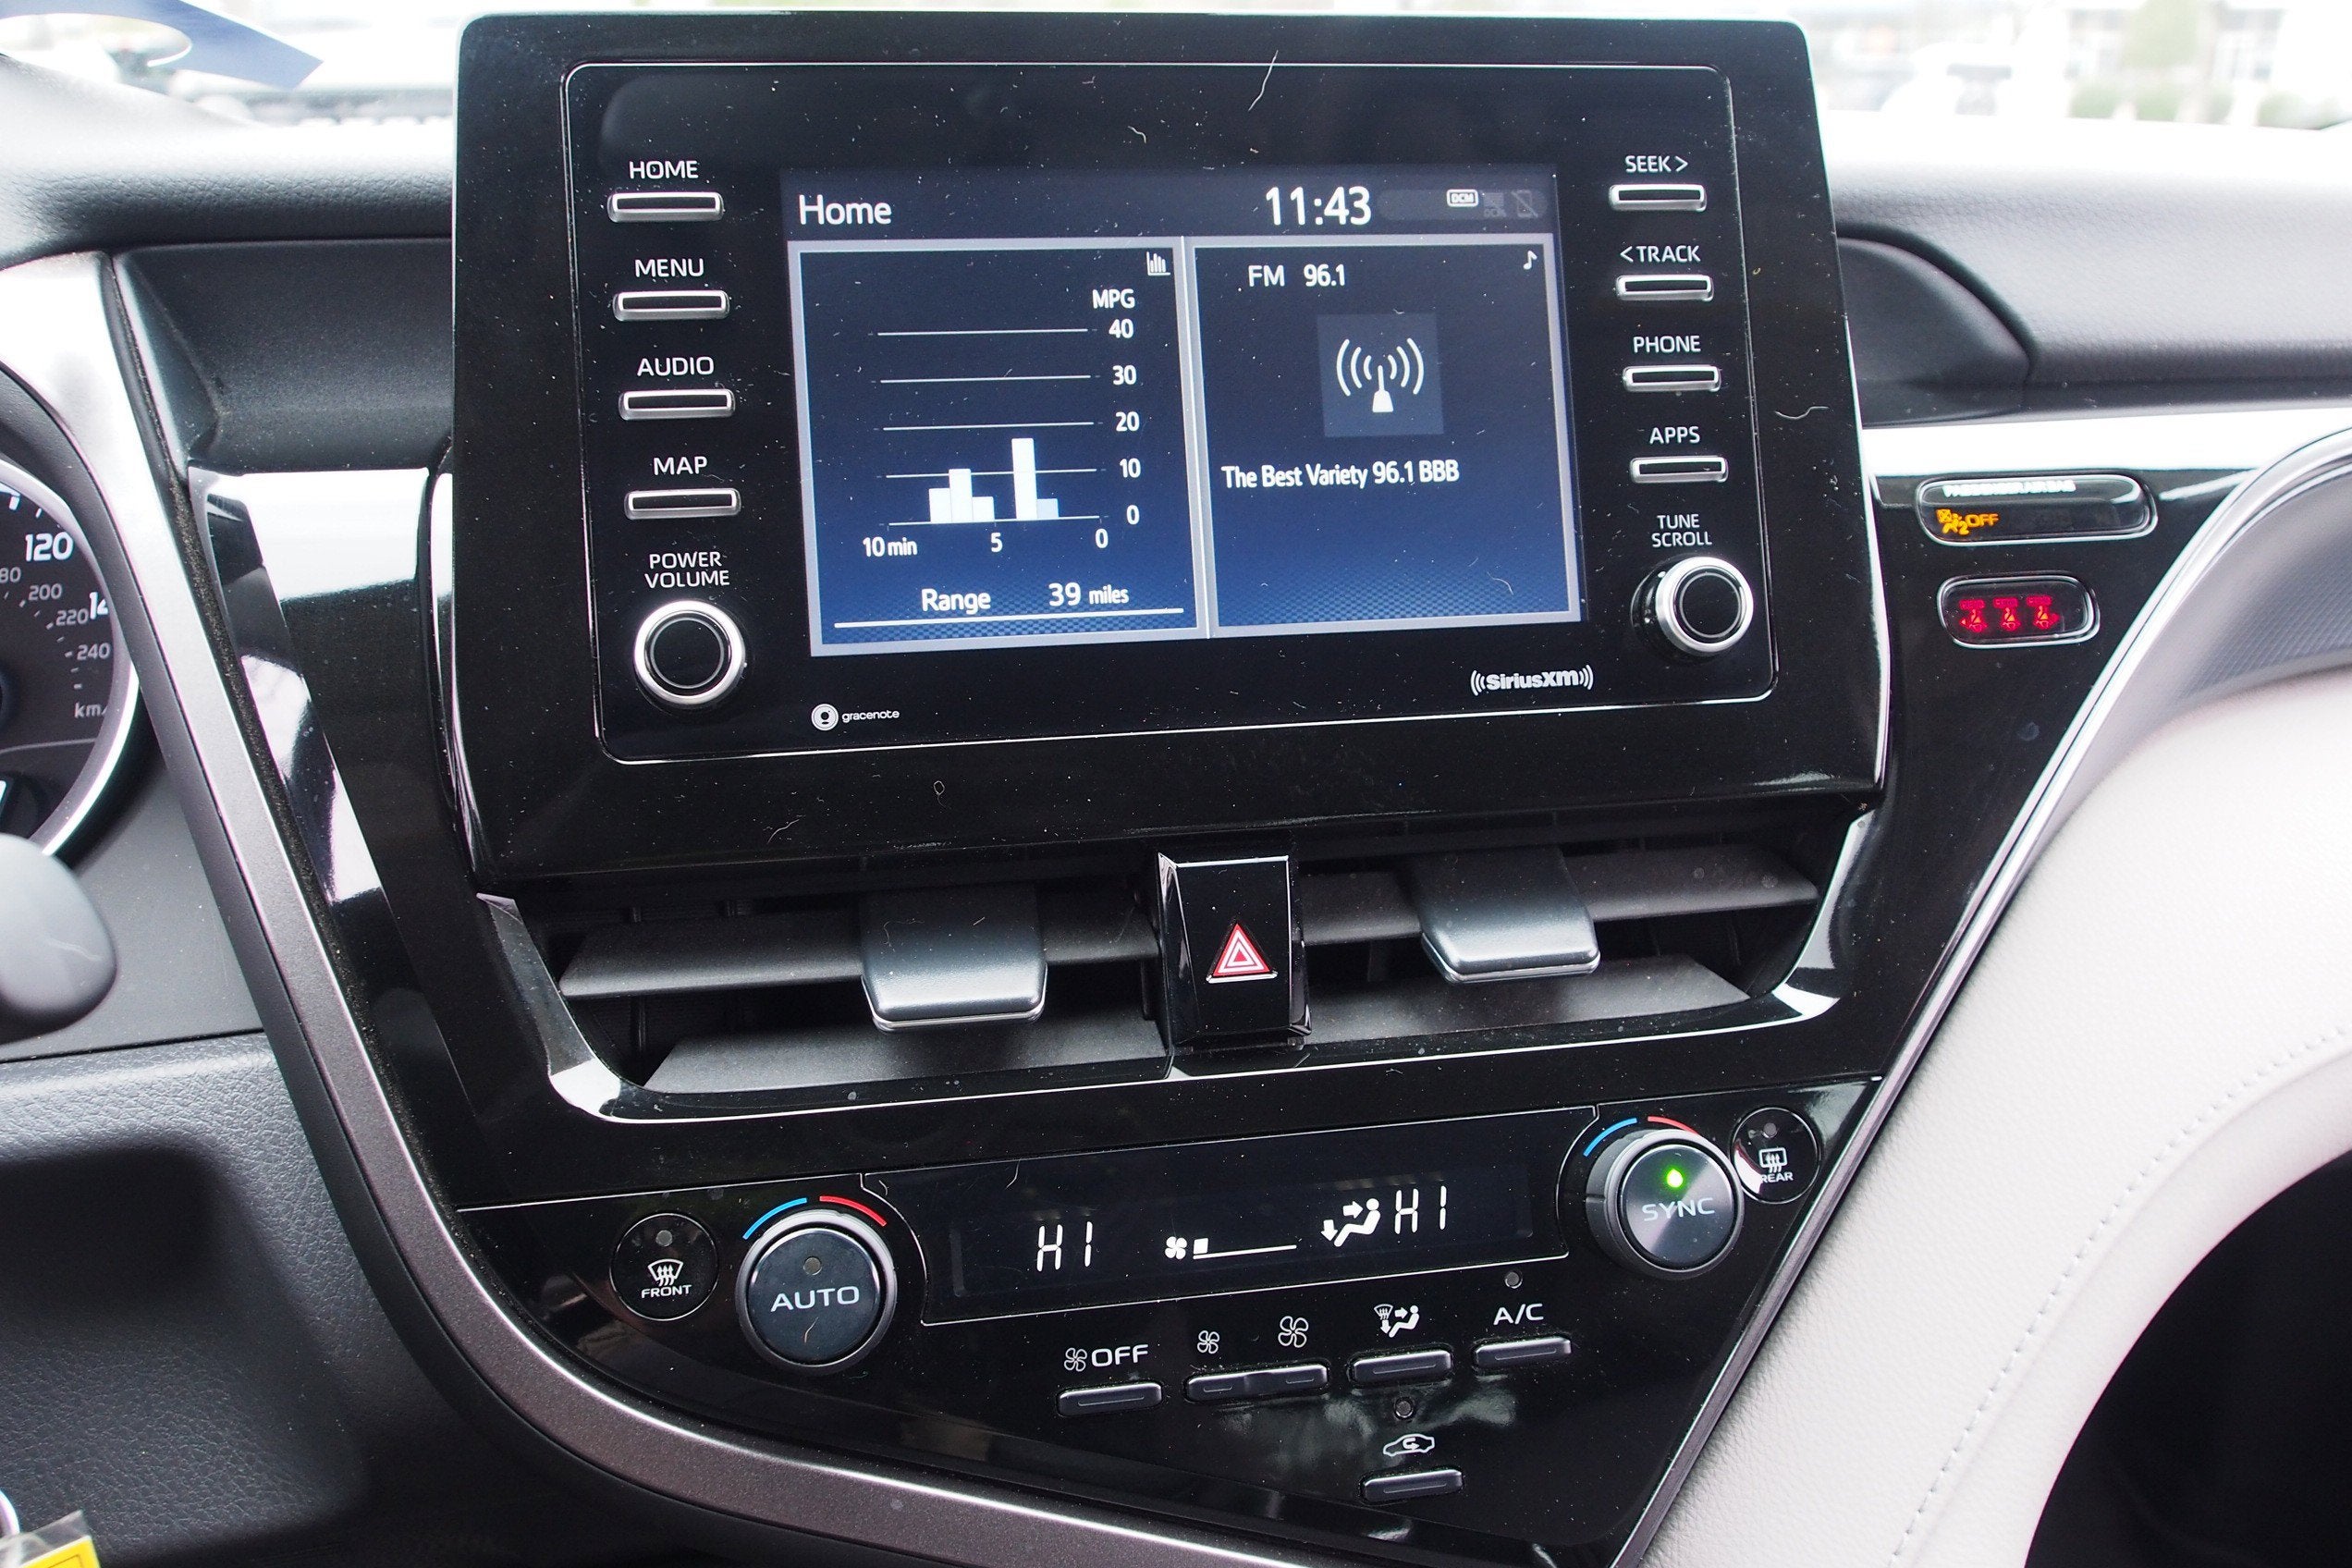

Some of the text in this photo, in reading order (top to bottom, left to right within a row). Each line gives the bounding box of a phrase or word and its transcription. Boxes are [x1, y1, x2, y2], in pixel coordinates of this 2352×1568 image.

[629, 160, 699, 179] HOME
[799, 193, 892, 226] Home
[1266, 185, 1372, 226] 11:43
[634, 258, 704, 278] MENU
[1248, 263, 1346, 288] FM 96.1
[1092, 288, 1136, 309] MPG
[1108, 318, 1134, 339] 40
[1633, 335, 1701, 353] PHONE
[636, 356, 715, 377] AUDIO
[1112, 364, 1137, 386] 30
[1115, 410, 1140, 432] 20
[1649, 425, 1701, 445] APPS
[653, 456, 708, 476] MAP
[1119, 457, 1142, 479] 10
[1220, 459, 1460, 490] The Best Variety 96.1 BBB
[1126, 504, 1140, 525] 0
[1657, 513, 1700, 530] TUNE
[1965, 513, 1999, 527] OFF
[25, 532, 74, 562] 120
[863, 528, 1109, 557] 10 min 5 0
[1651, 531, 1713, 548] SCROLL
[649, 550, 723, 570] POWER
[643, 570, 730, 589] VOLUME
[28, 582, 63, 601] 200
[922, 582, 1130, 616] Range 39 miles
[55, 607, 90, 626] 220
[77, 642, 112, 661] 240
[841, 709, 900, 724] gracenote
[1760, 1171, 1794, 1183] REAR
[1642, 1197, 1715, 1221] SYNC
[641, 1284, 692, 1299] FRONT
[770, 1285, 860, 1313] AUTO
[1493, 1303, 1544, 1326] A/C
[1091, 1343, 1149, 1367] OFF
